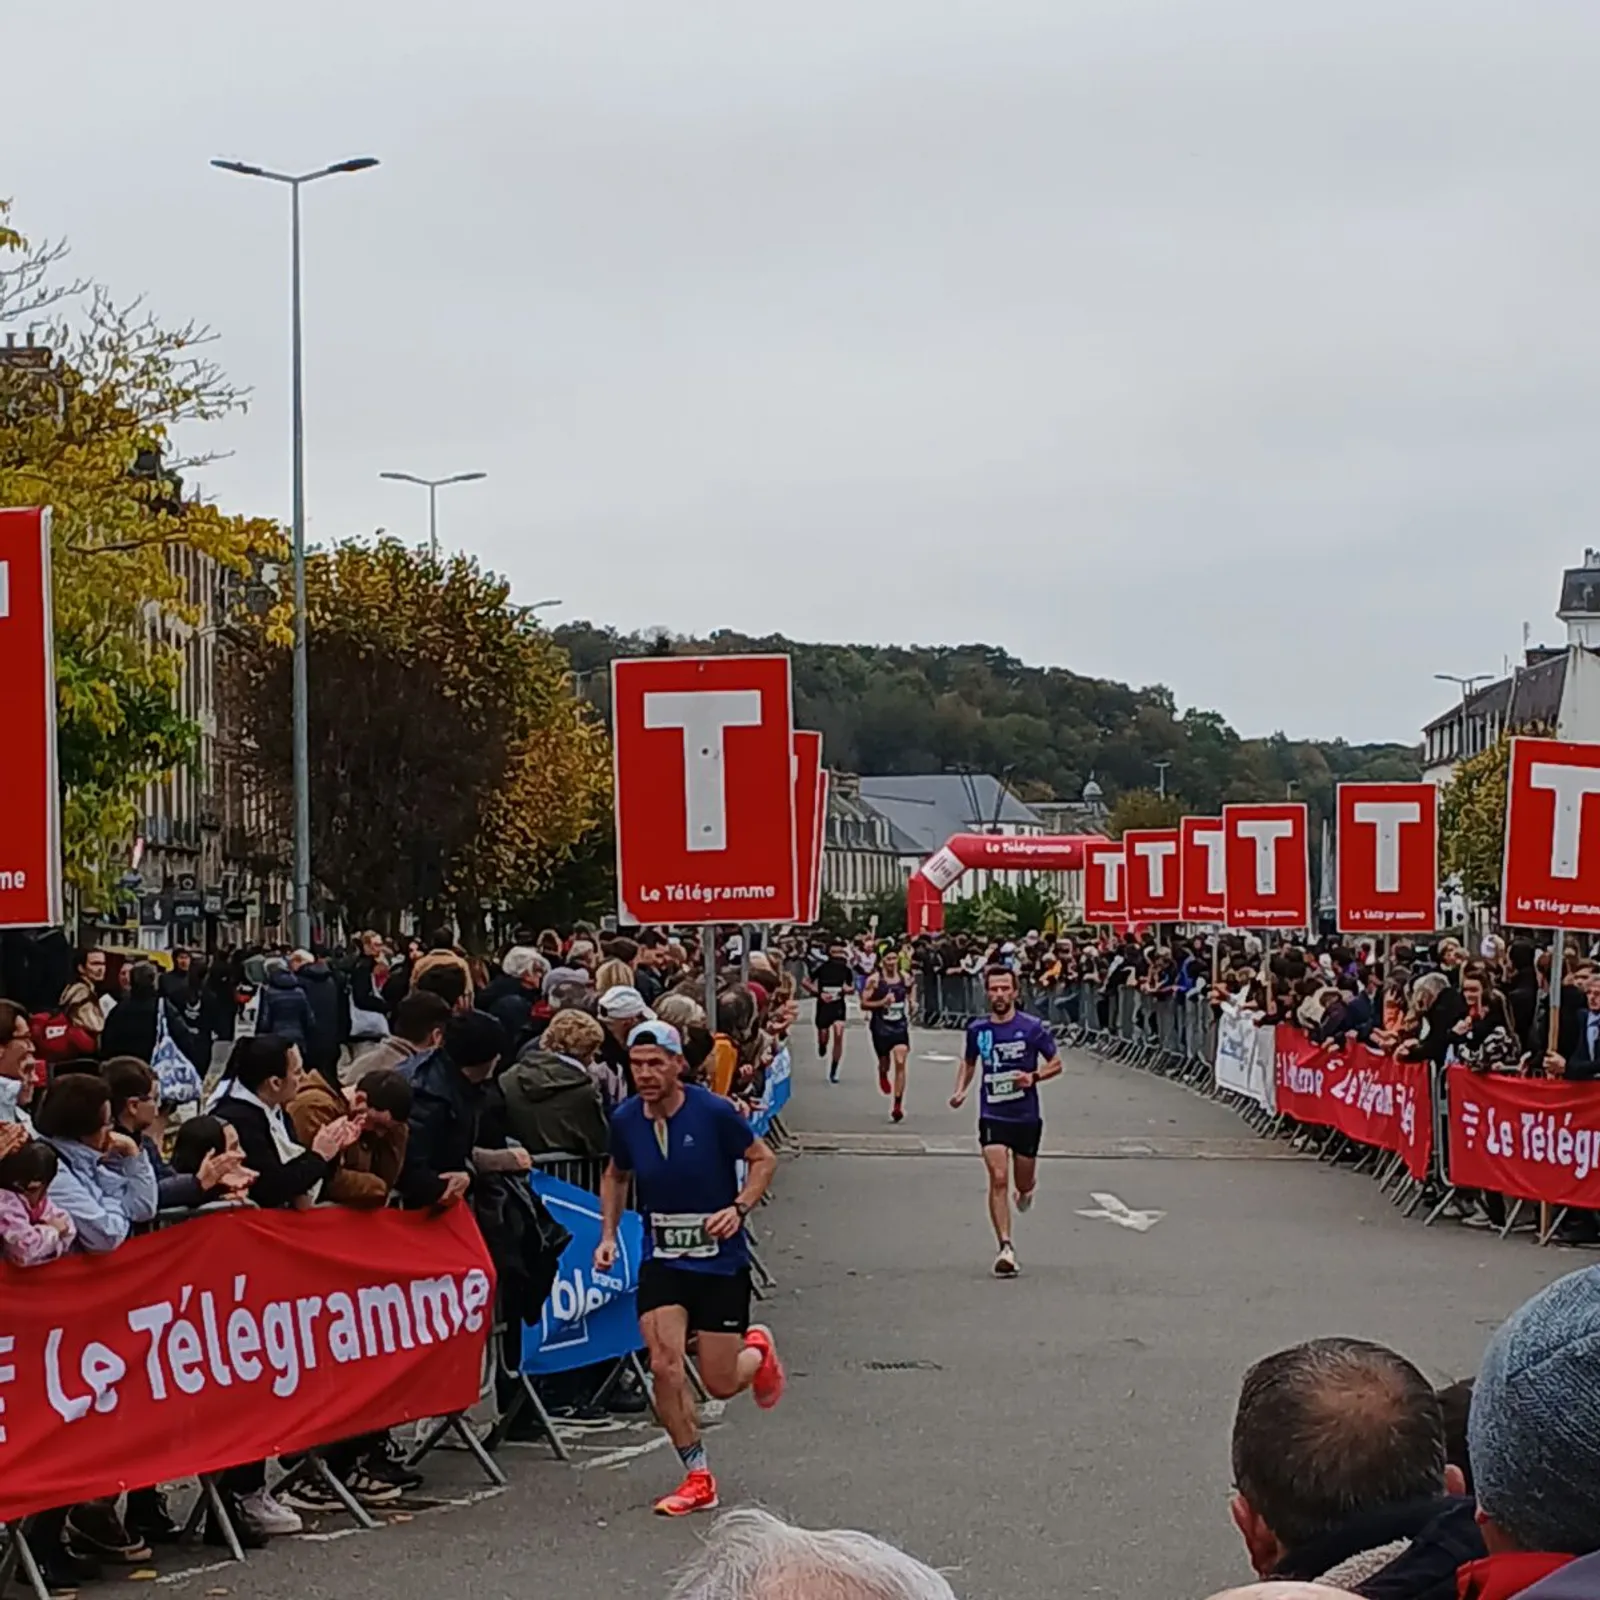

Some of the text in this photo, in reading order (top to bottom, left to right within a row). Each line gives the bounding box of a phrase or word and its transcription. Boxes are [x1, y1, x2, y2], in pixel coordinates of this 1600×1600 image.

[644, 690, 762, 851] T
[1353, 802, 1420, 893] T
[1530, 763, 1600, 879] T
[1093, 852, 1125, 902] T
[1134, 841, 1176, 898] T
[1193, 830, 1226, 894] T
[1237, 819, 1293, 896] T
[641, 882, 775, 903] Le Télégramme
[1517, 896, 1531, 910] Le
[1486, 1107, 1514, 1158] Le
[664, 1228, 702, 1246] 6171
[45, 1268, 490, 1423] Le Télégramme
